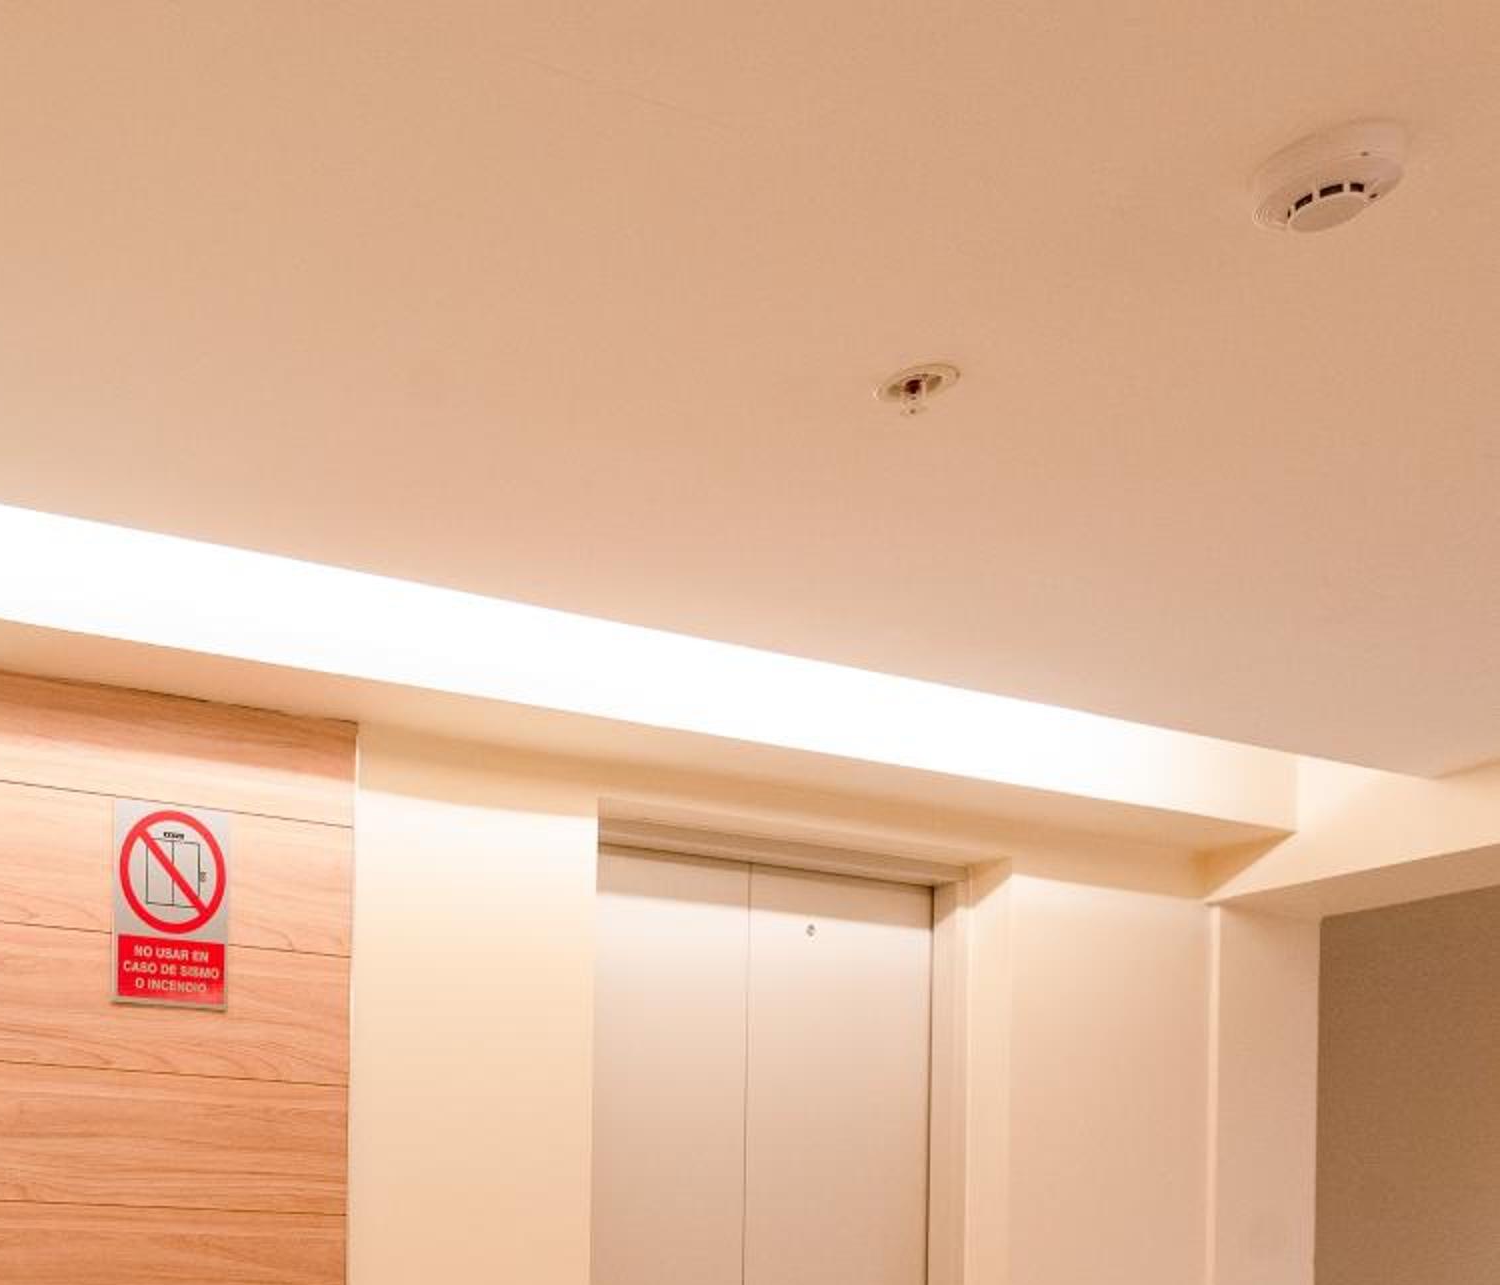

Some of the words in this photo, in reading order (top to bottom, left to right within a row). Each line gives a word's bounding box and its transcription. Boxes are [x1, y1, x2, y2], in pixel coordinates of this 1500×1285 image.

[133, 945, 153, 958] NO
[155, 947, 189, 961] USAR
[192, 950, 209, 963] EN
[123, 960, 158, 975] CASO
[160, 963, 177, 976] DE
[180, 965, 219, 980] SISMO
[135, 977, 145, 989] O
[147, 978, 207, 993] INCENDIO
